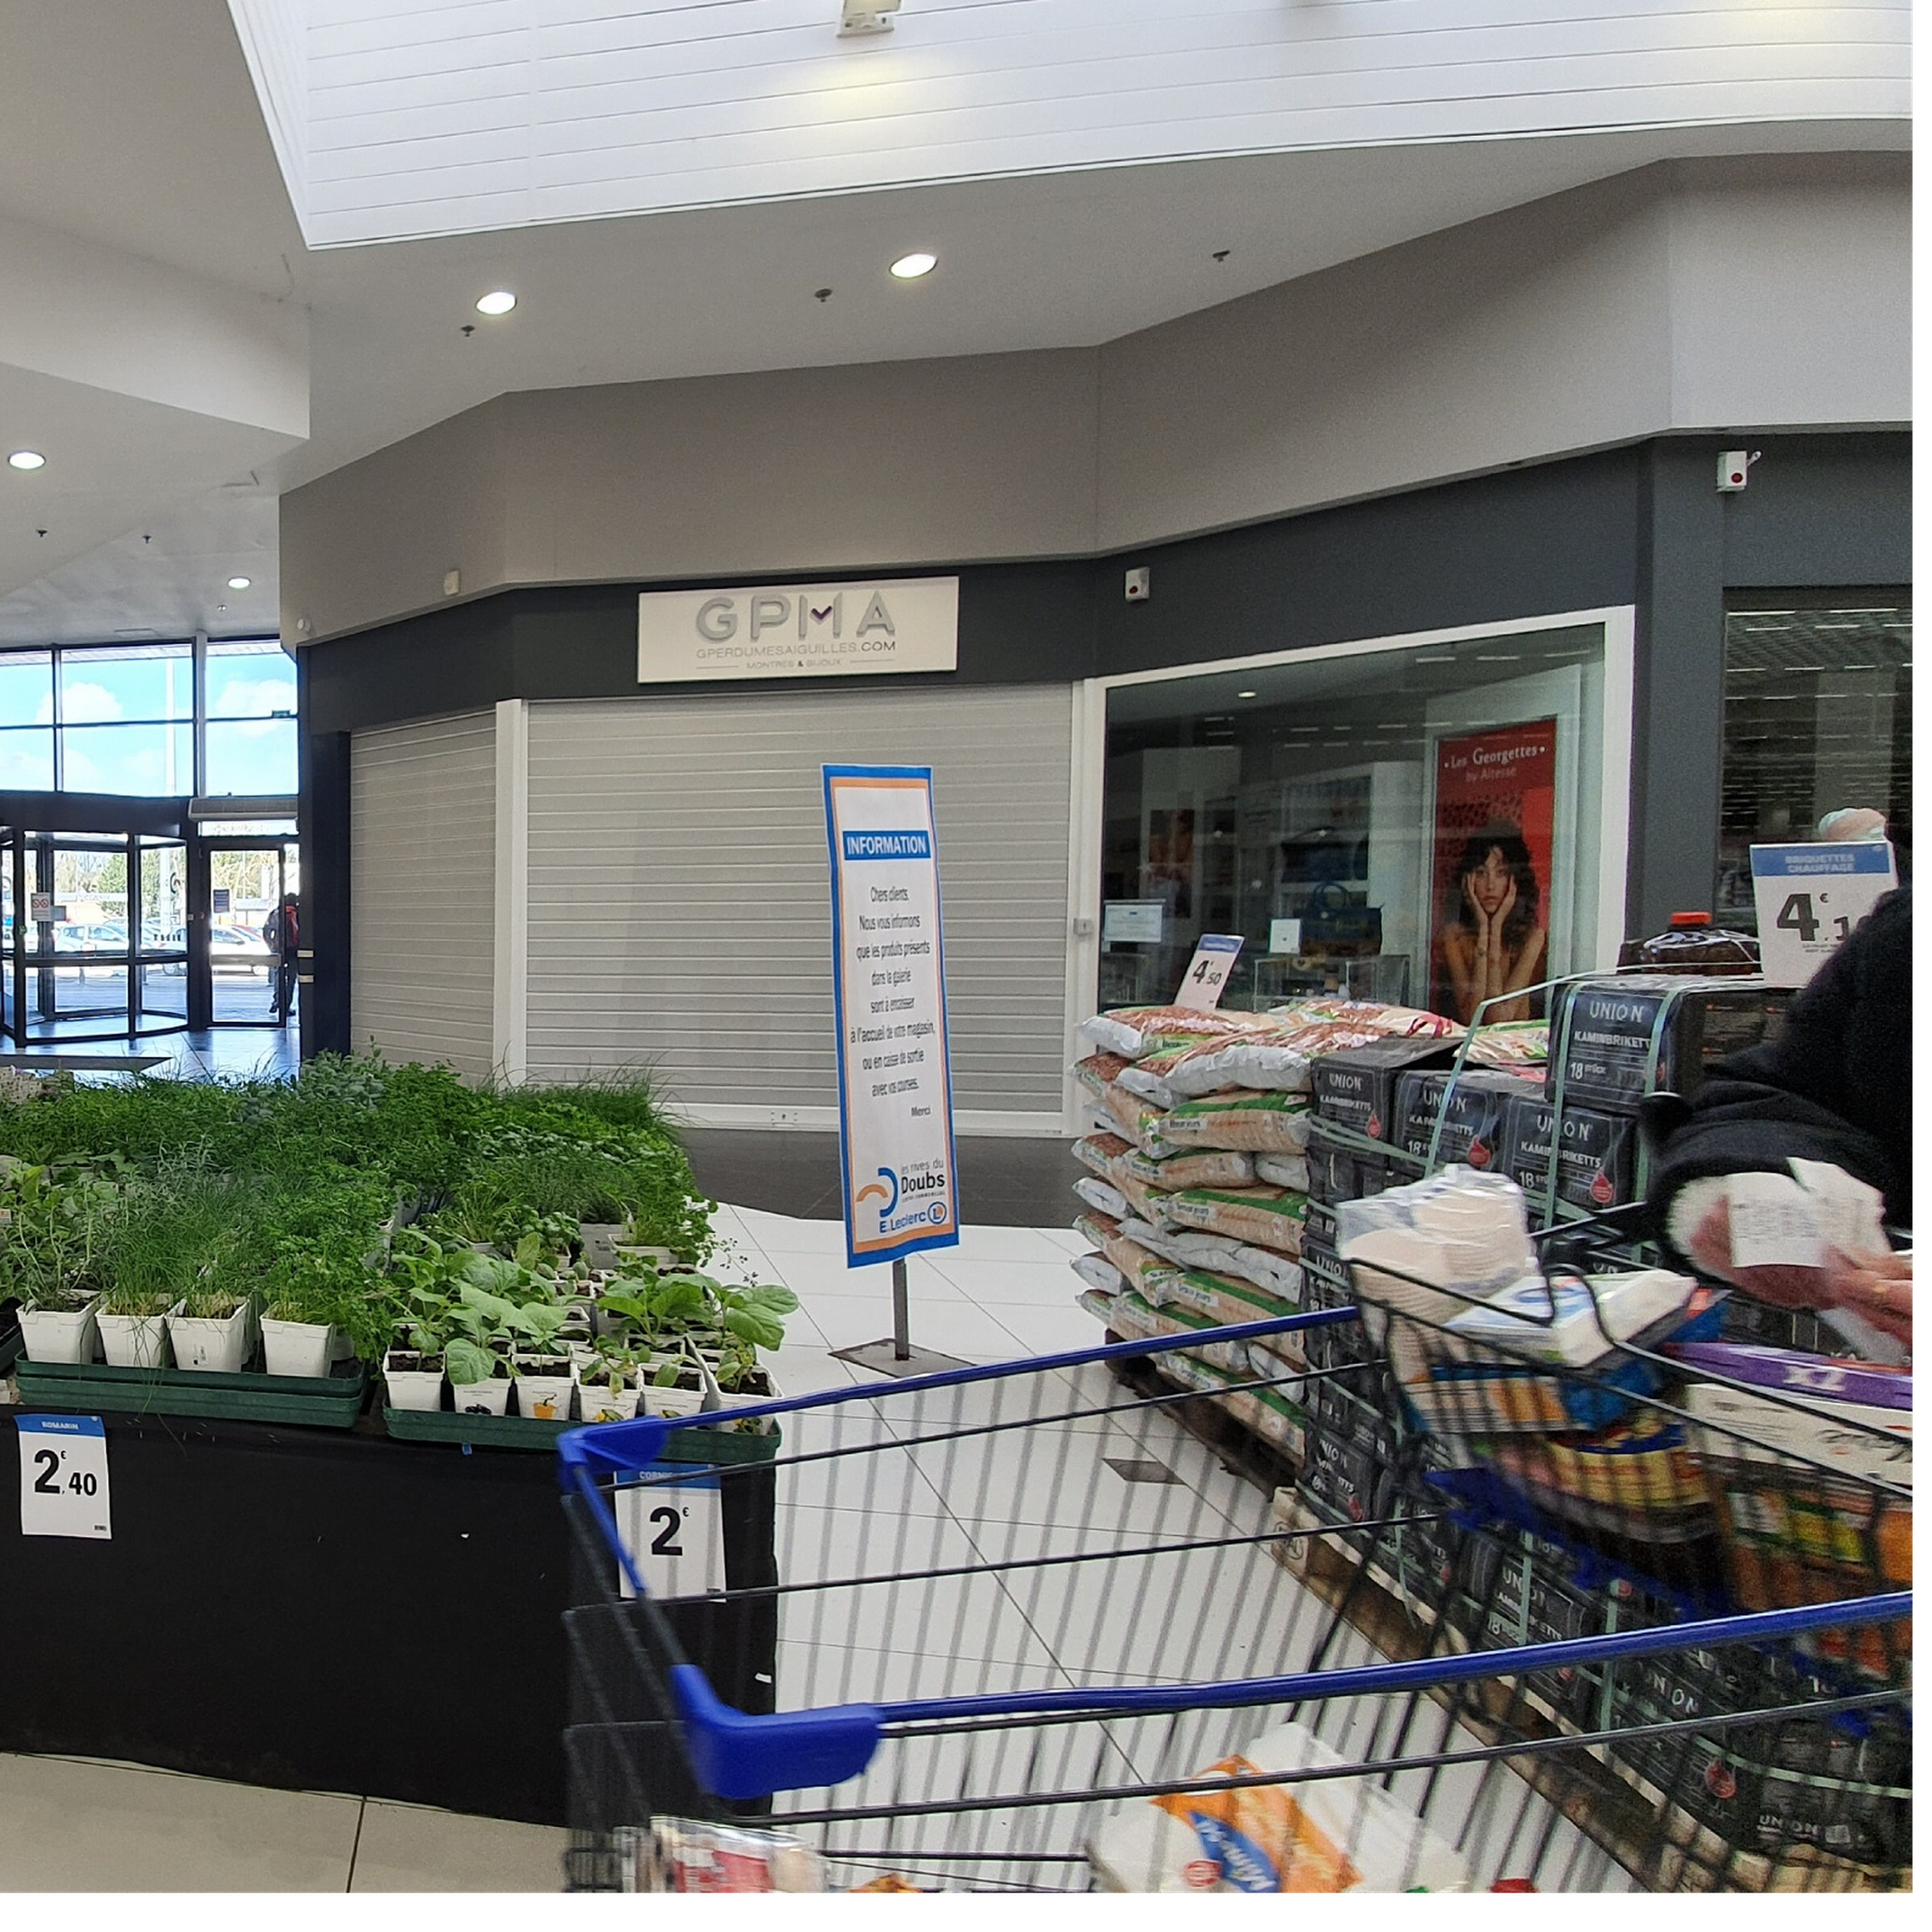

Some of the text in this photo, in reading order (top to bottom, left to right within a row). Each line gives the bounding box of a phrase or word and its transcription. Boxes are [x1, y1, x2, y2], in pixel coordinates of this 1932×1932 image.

[696, 591, 896, 644] GPMA
[746, 659, 794, 669] MONTRES
[1451, 746, 1537, 769] Les Georgettes
[847, 836, 927, 855] INFORMATION
[1589, 1000, 1643, 1023] UNION
[1574, 1030, 1652, 1048] KAMINBRIKETT
[1569, 1062, 1584, 1079] 18
[1329, 1073, 1363, 1091] UNION
[911, 1106, 931, 1117] Merci
[1537, 1114, 1590, 1141] UNON
[933, 1157, 944, 1168] du
[901, 1172, 945, 1195] Doubs
[1519, 1171, 1535, 1189] 18
[41, 1421, 79, 1430] ROMARIN
